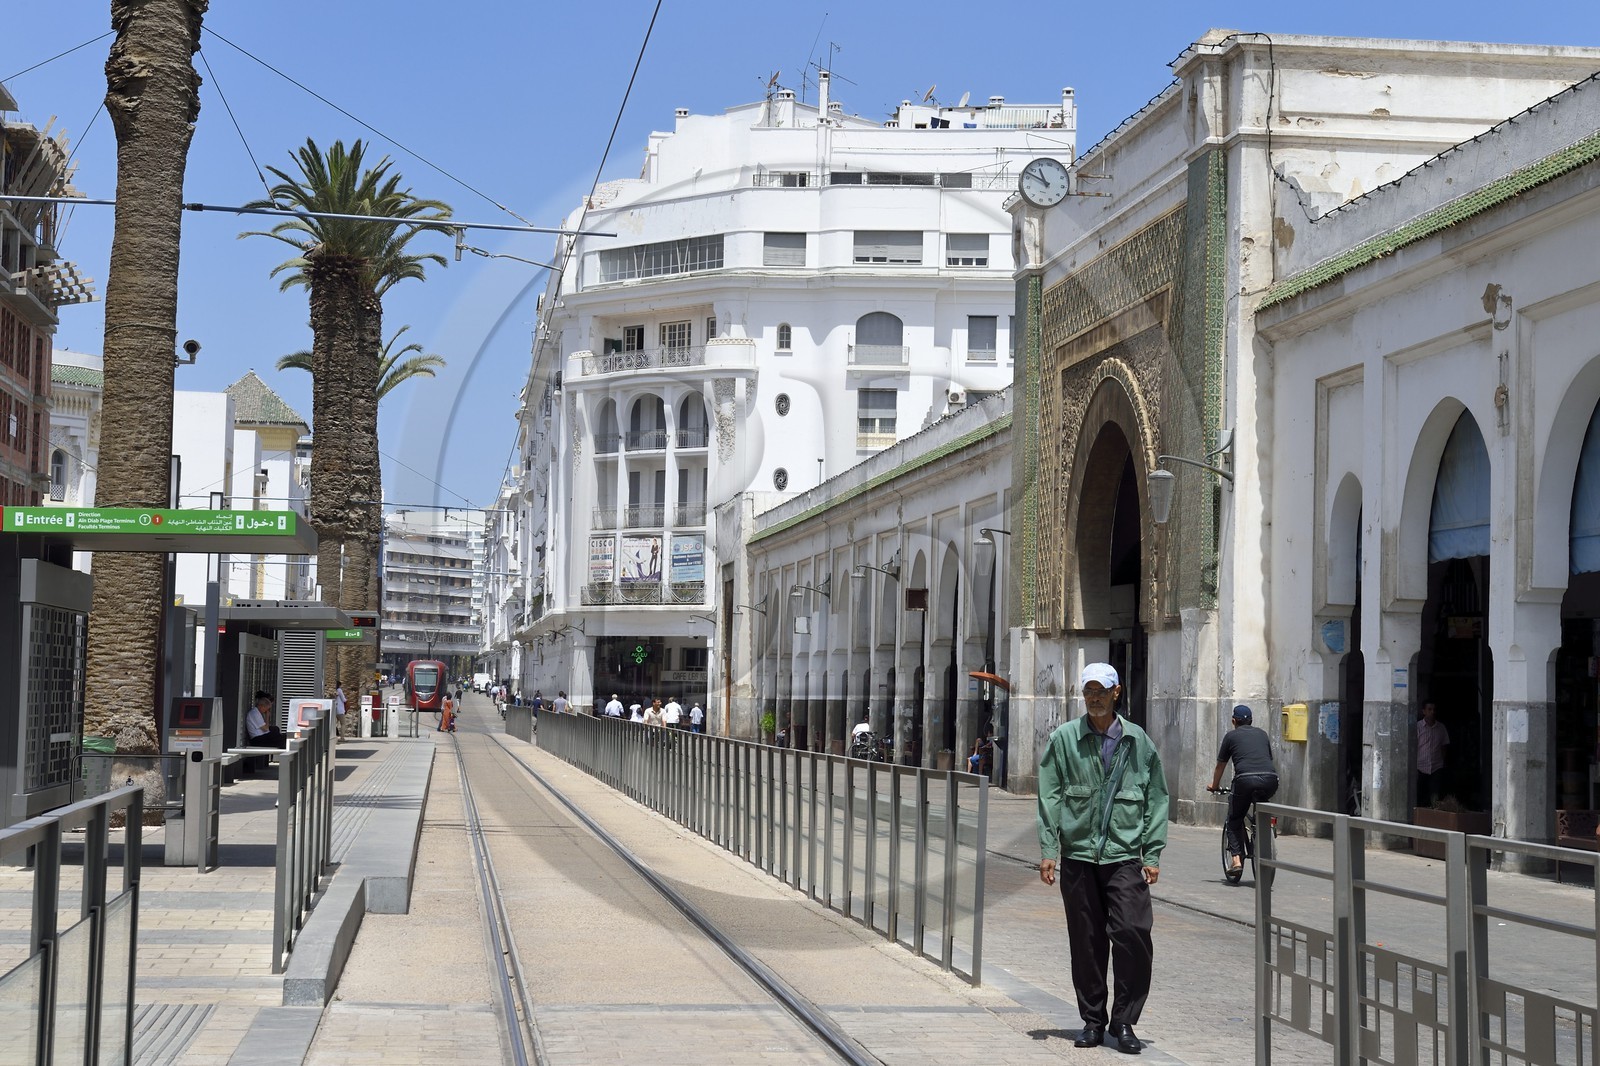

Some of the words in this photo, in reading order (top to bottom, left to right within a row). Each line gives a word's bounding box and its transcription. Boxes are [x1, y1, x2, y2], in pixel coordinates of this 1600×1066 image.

[26, 514, 63, 525] Entrée
[246, 517, 274, 528] دخول
[672, 672, 686, 680] CAFE
